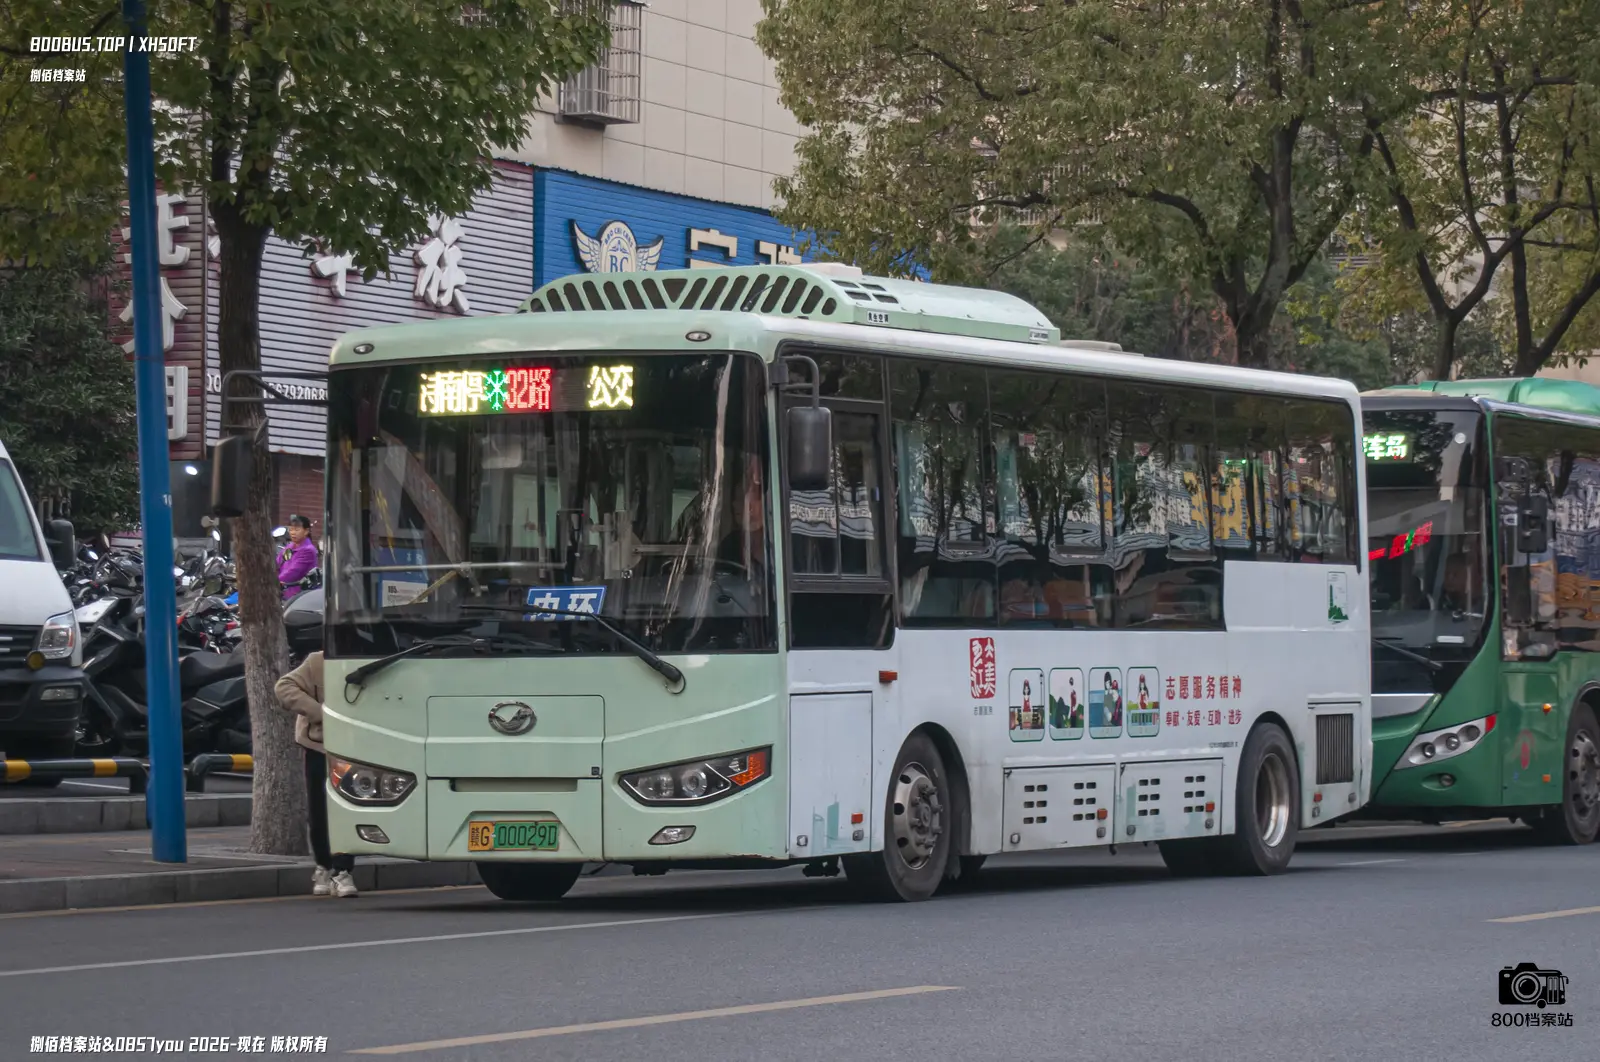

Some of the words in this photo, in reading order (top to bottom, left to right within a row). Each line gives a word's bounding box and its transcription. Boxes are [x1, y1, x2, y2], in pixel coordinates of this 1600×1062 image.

[587, 364, 634, 409] 公交
[530, 592, 598, 622] 内环
[1165, 675, 1242, 700] 志愿服务精神
